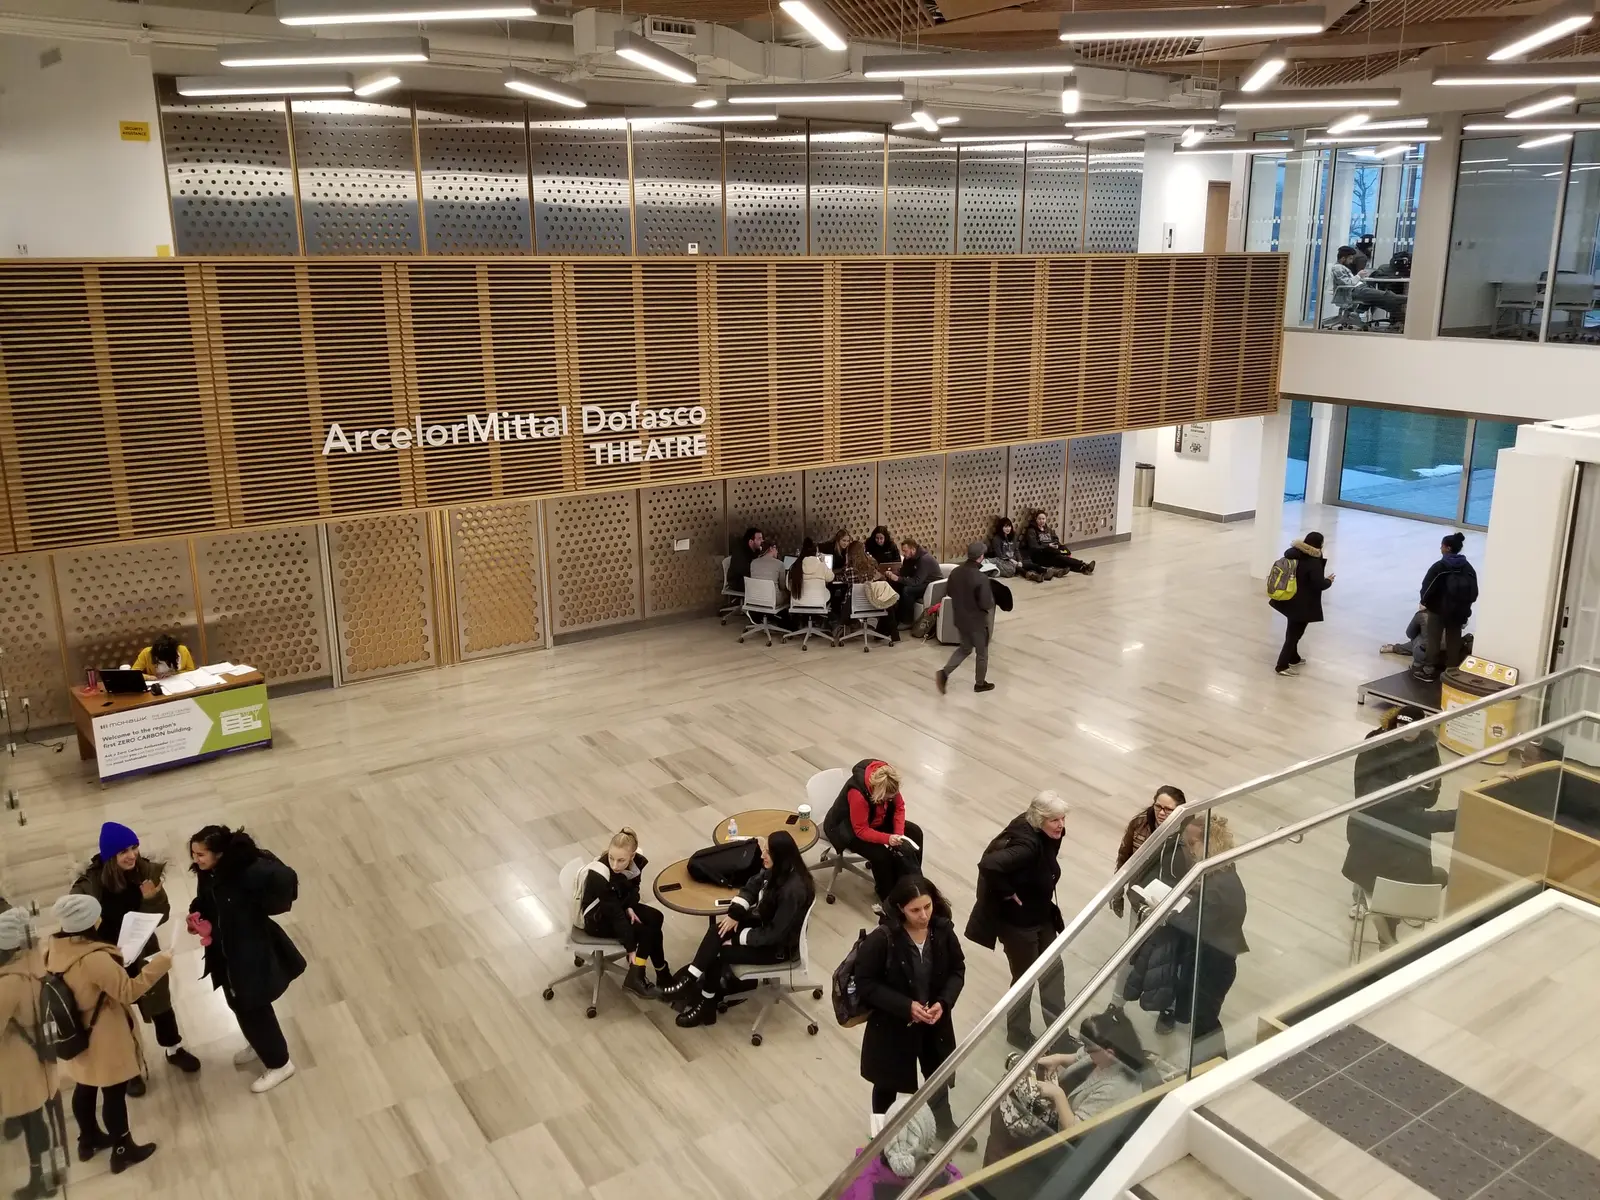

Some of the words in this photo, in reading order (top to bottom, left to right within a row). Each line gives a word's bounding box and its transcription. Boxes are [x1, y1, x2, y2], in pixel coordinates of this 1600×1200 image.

[321, 405, 569, 455] ArcelorMittal
[582, 400, 707, 434] Dofasco
[590, 434, 708, 466] THEATRE
[102, 731, 131, 742] Welcome
[152, 722, 176, 732] region's
[117, 737, 136, 746] ZERO
[137, 731, 166, 741] CARBON
[166, 726, 193, 735] building.
